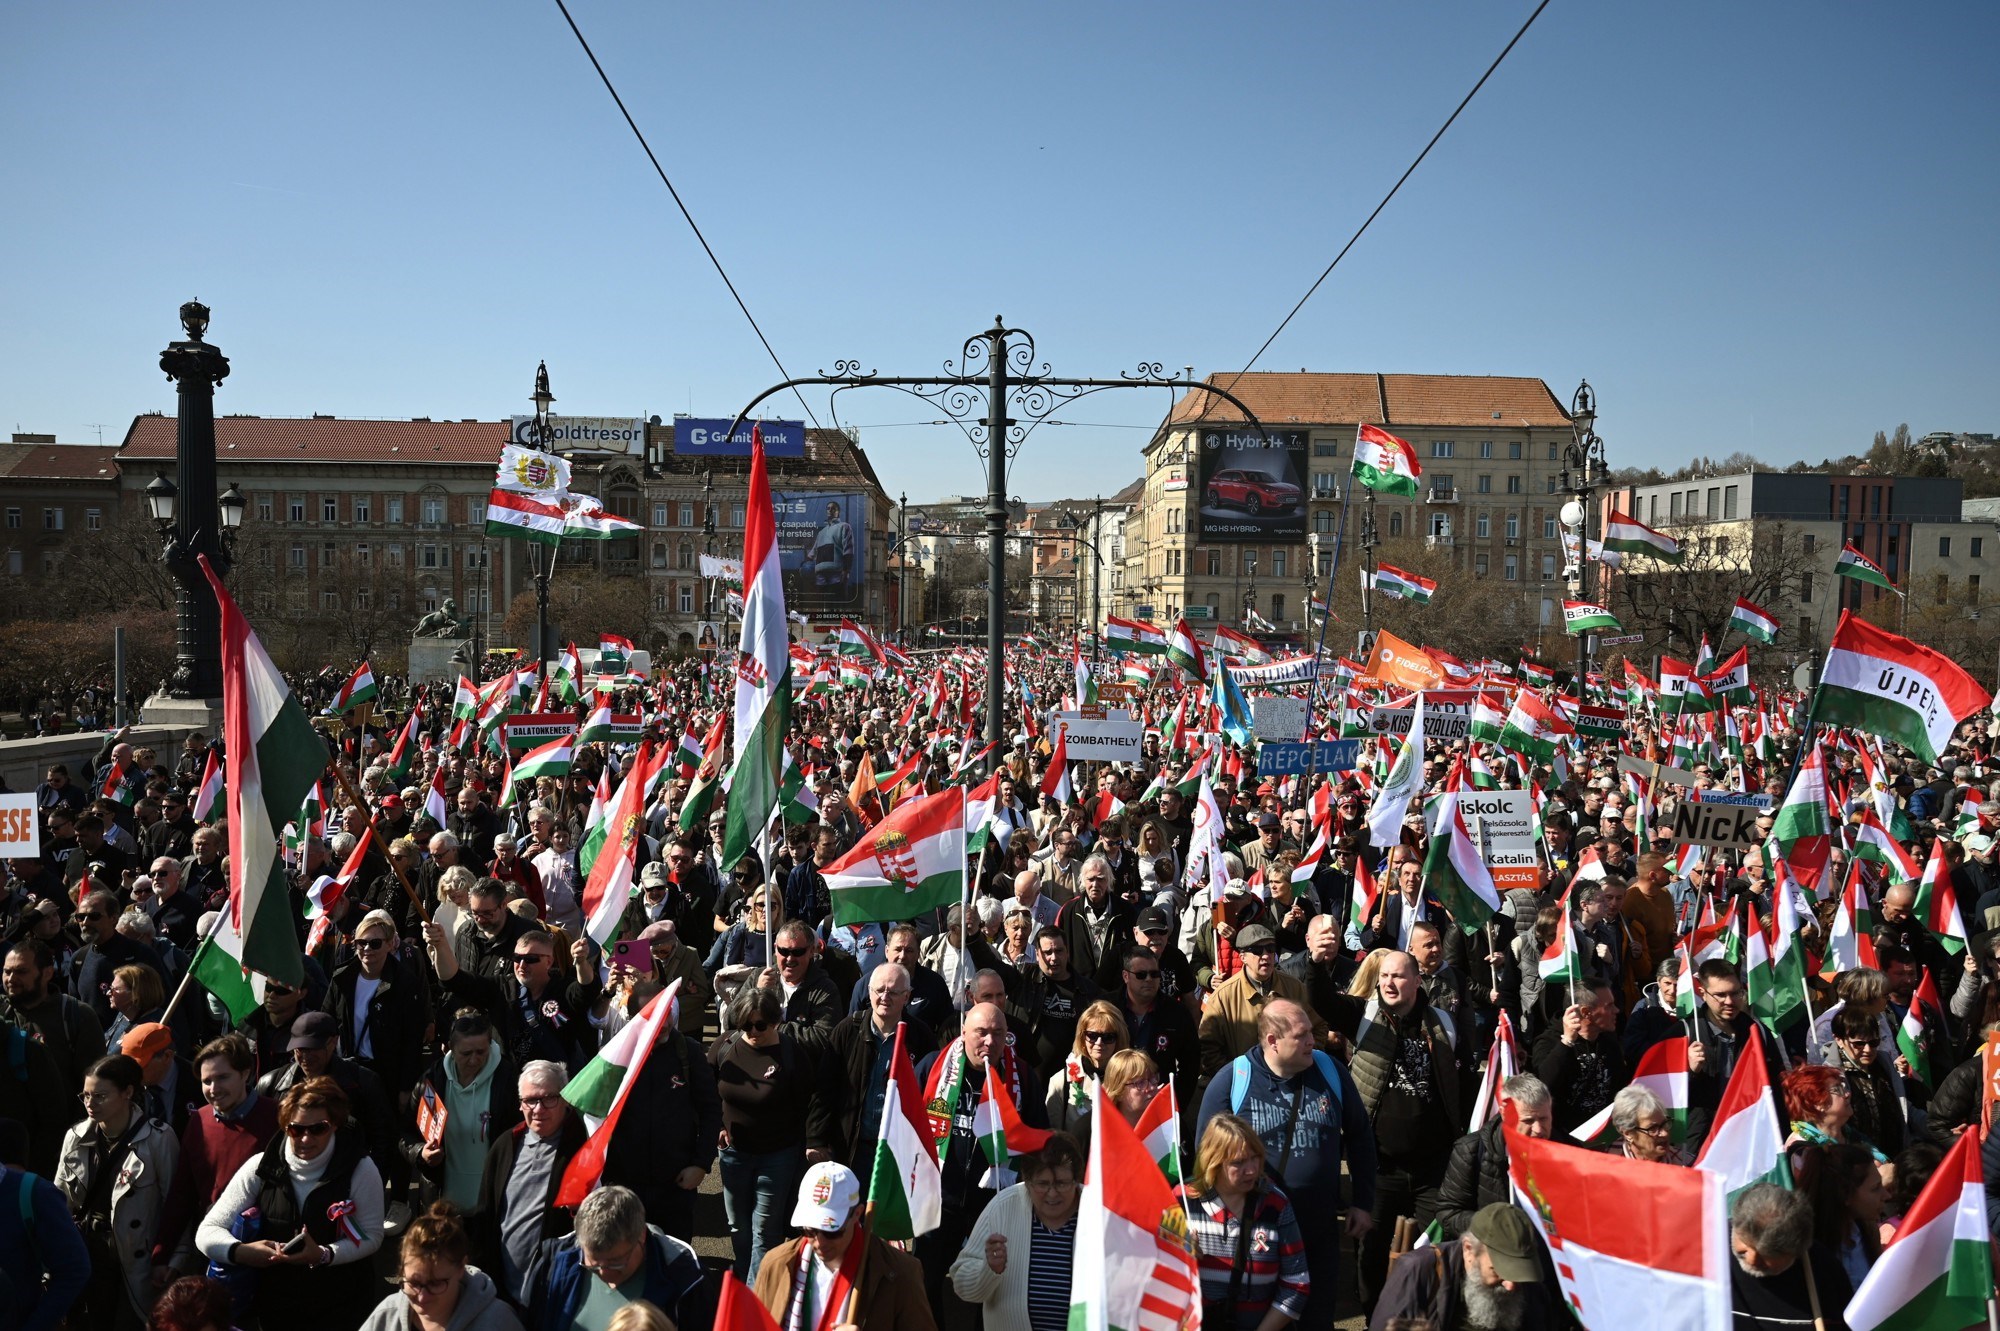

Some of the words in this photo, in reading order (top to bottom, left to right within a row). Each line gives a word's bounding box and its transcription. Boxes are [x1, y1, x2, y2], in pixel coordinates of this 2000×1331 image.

[546, 425, 641, 441] oldtresor
[711, 431, 751, 444] Grnit
[764, 433, 787, 444] ank
[782, 520, 819, 530] csapatot,
[1204, 525, 1218, 533] MG
[1219, 525, 1229, 533] HS
[1230, 525, 1261, 533] HYBRID+
[786, 530, 814, 538] erstés!
[1395, 656, 1440, 680] FIDELITAS
[513, 726, 571, 735] BALATONKENESE
[1390, 712, 1466, 739] KISSZÁLLÁS
[1065, 735, 1138, 747] ZOMBATHELY
[1261, 746, 1358, 770] RÉPCELAK
[1457, 799, 1513, 815] iskolc
[1675, 805, 1755, 843] Nick
[1488, 854, 1534, 864] Katalin
[1493, 873, 1533, 882] LASZTÁS
[1250, 1096, 1291, 1136] HARDES
